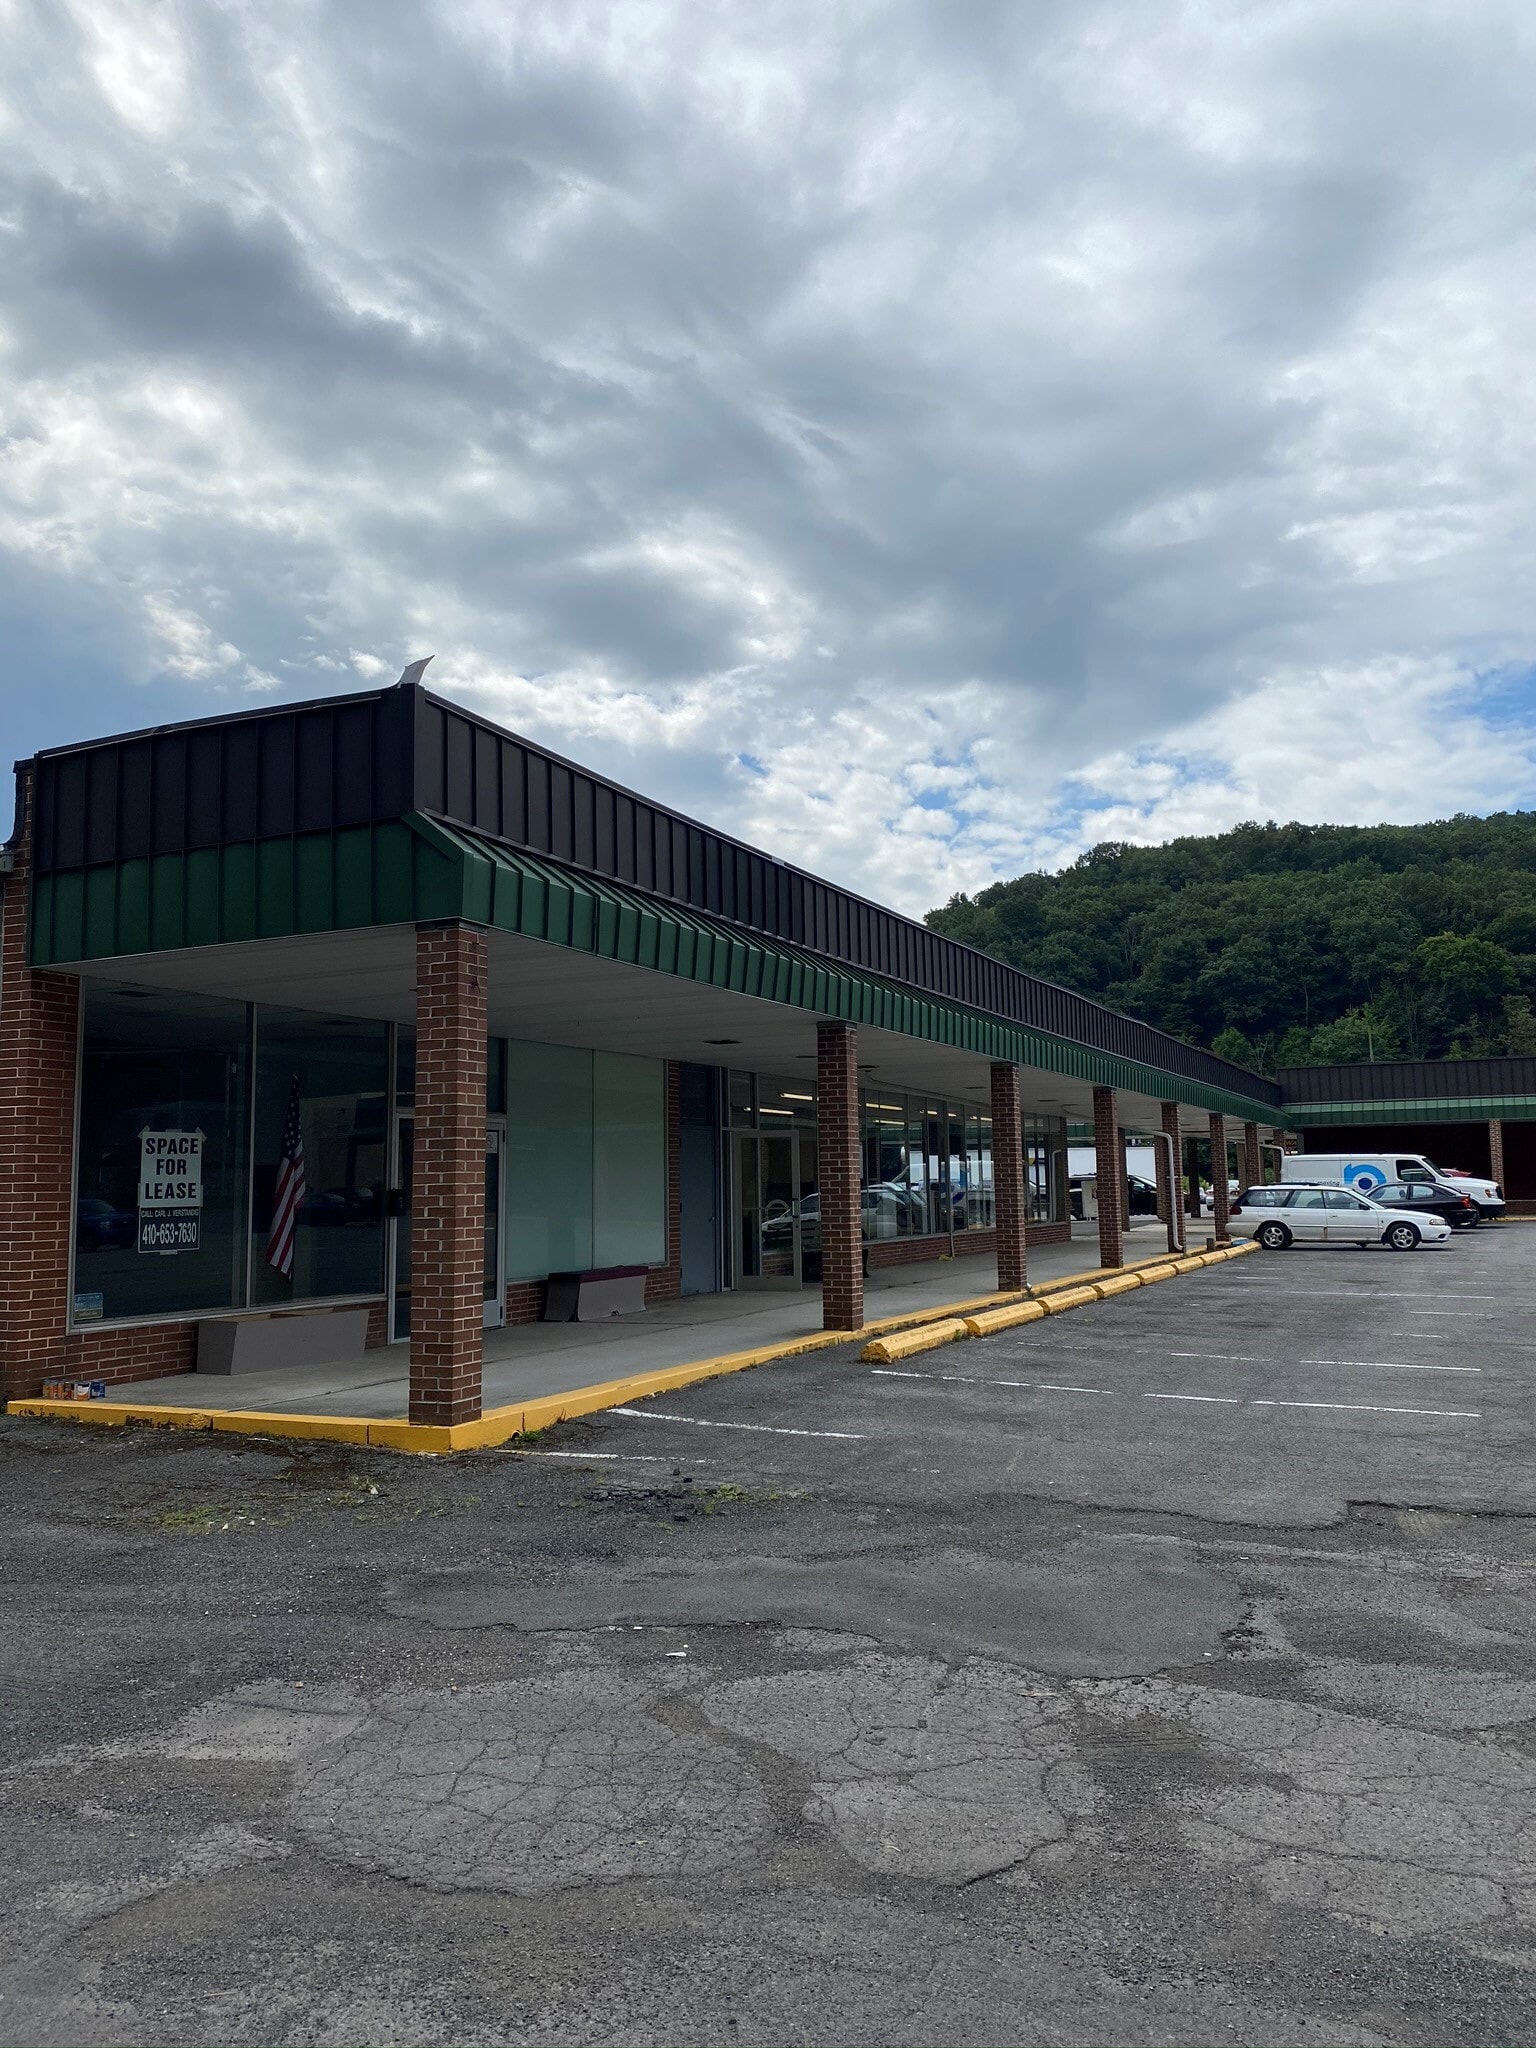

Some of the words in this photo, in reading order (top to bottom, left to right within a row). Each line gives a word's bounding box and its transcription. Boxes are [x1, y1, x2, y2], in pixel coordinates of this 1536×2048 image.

[145, 1137, 199, 1155] SPACE
[155, 1158, 187, 1176] FOR
[145, 1182, 197, 1200] LEASE
[154, 1210, 167, 1218] CARL
[142, 1222, 197, 1245] 410-653-7630
